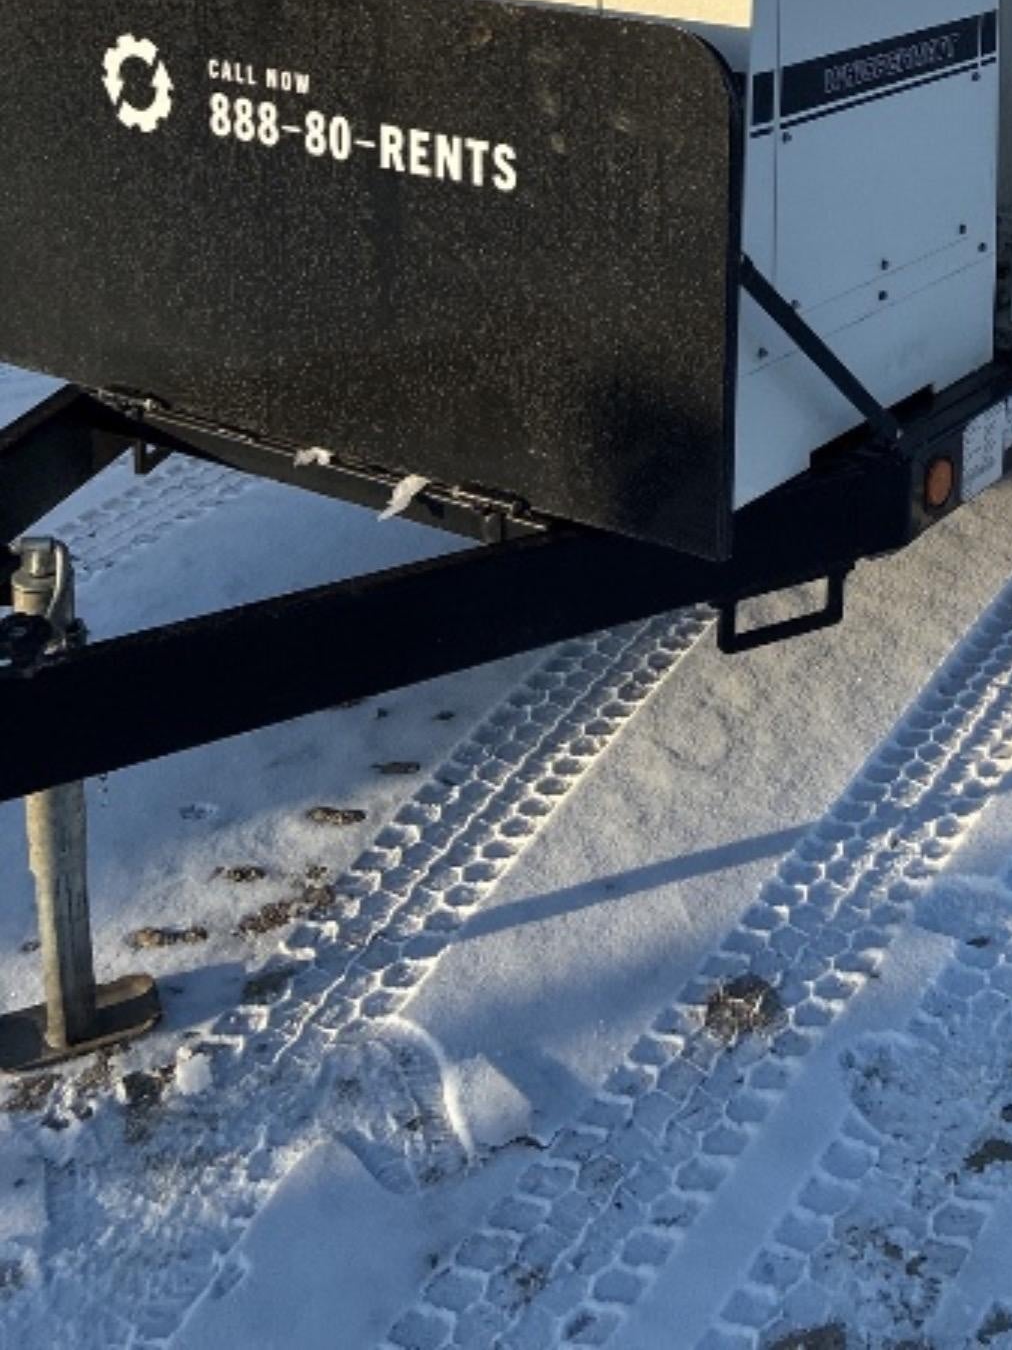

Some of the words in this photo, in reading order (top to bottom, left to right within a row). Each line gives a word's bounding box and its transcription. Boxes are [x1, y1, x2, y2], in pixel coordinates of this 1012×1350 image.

[208, 59, 257, 85] CALL
[265, 68, 310, 94] NOW
[209, 92, 517, 191] 888-80-RENTS
